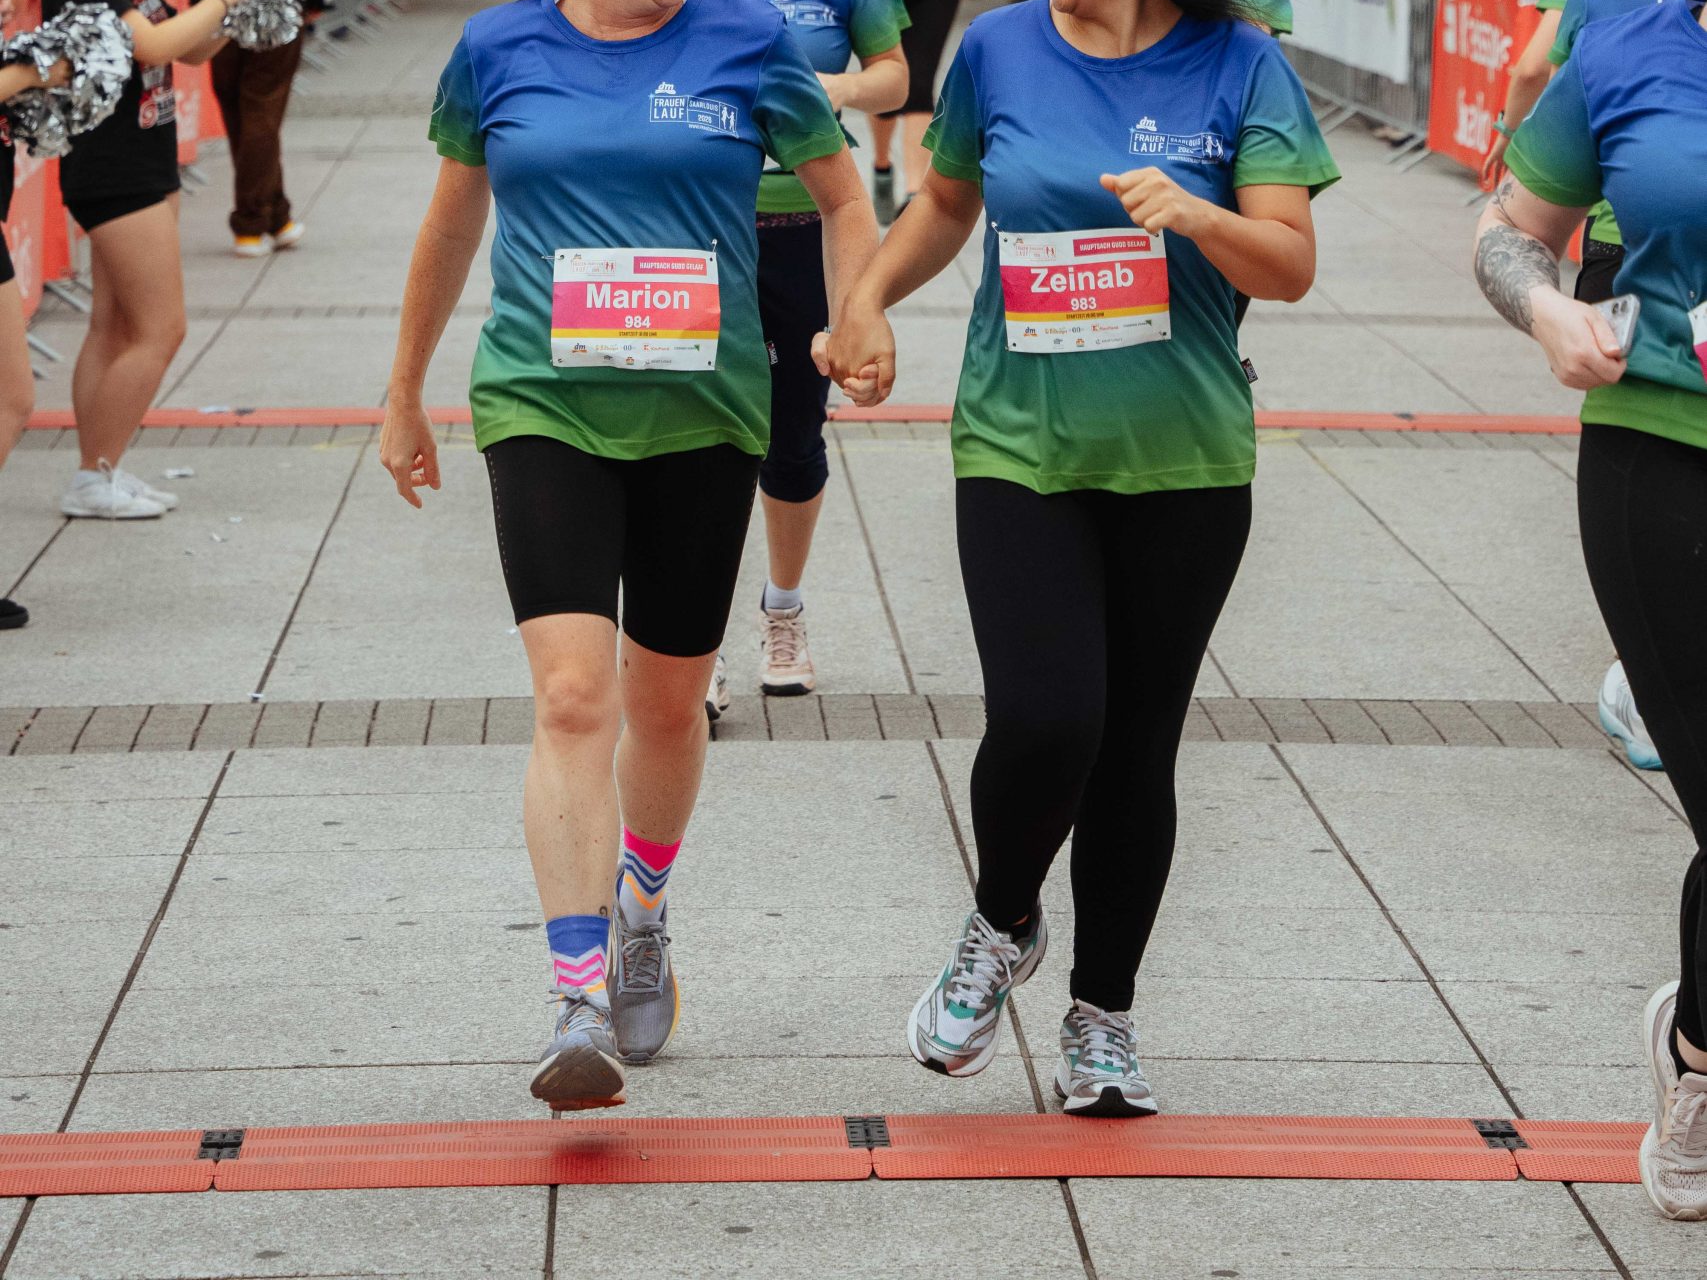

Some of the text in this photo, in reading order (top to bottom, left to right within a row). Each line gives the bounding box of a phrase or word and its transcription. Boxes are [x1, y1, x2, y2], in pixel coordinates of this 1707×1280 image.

[654, 98, 685, 107] FRAUEN
[653, 108, 685, 119] LAUF
[1134, 133, 1165, 143] FRAUEN
[1133, 142, 1164, 153] LAUF
[1030, 262, 1134, 293] Zeinab
[586, 283, 690, 309] Marion
[1070, 297, 1097, 311] 983
[624, 315, 651, 329] 984
